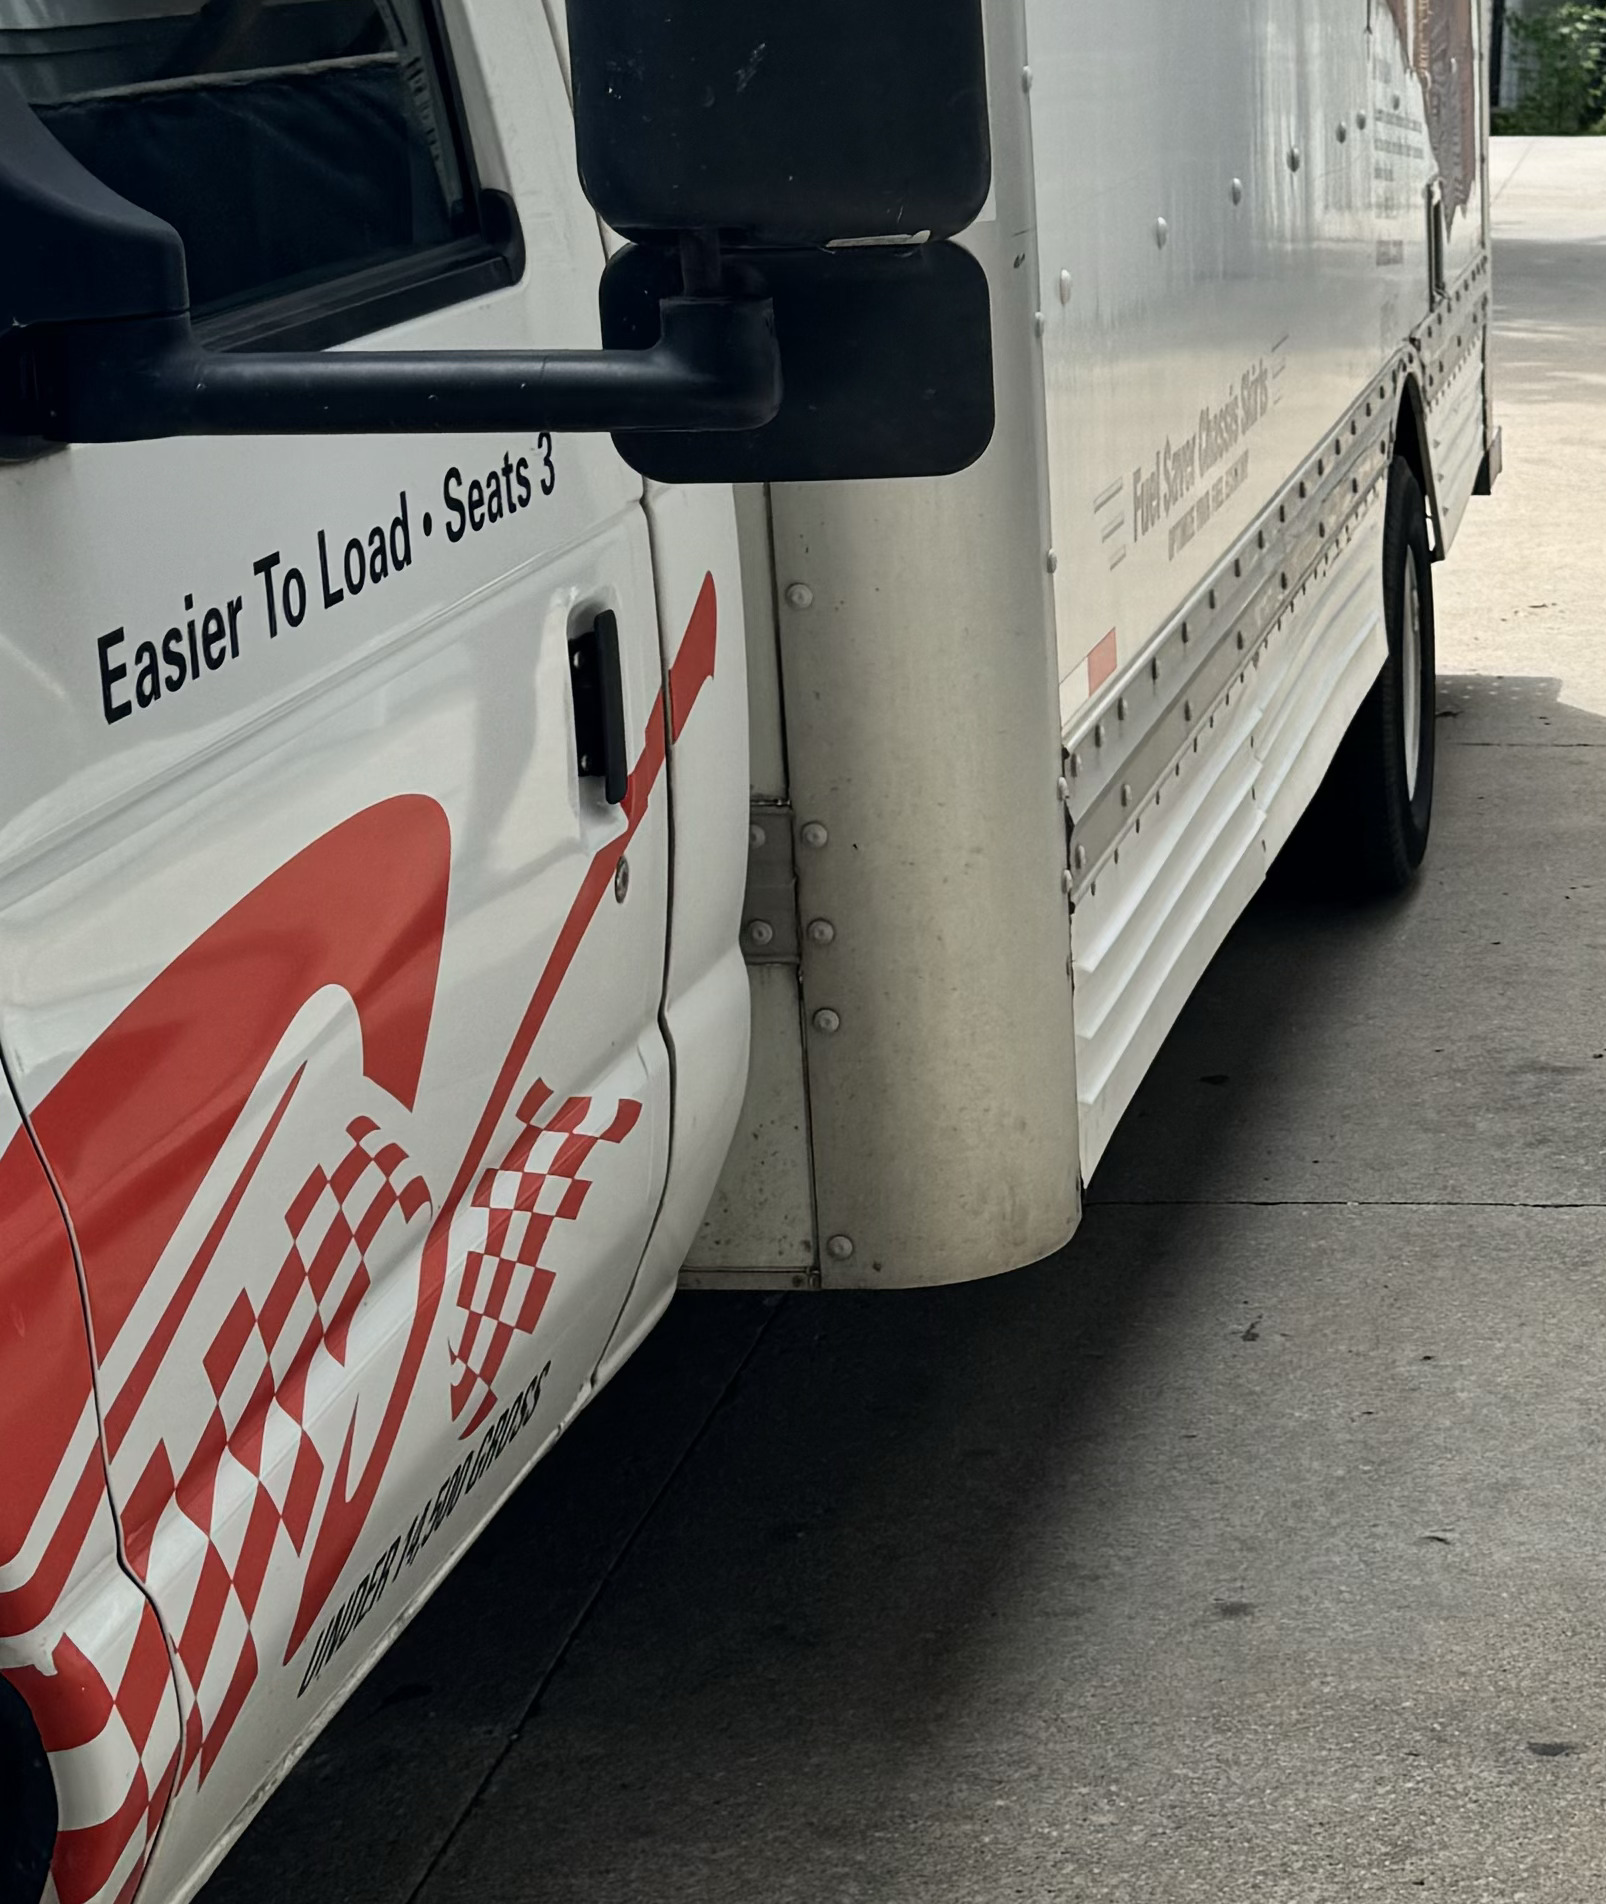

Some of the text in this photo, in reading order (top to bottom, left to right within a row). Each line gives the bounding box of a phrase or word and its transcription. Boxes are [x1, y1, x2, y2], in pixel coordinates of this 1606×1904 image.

[97, 430, 556, 725] Easier To Load Seats 3
[297, 1359, 552, 1699] UNDER 14,500 GROSS
